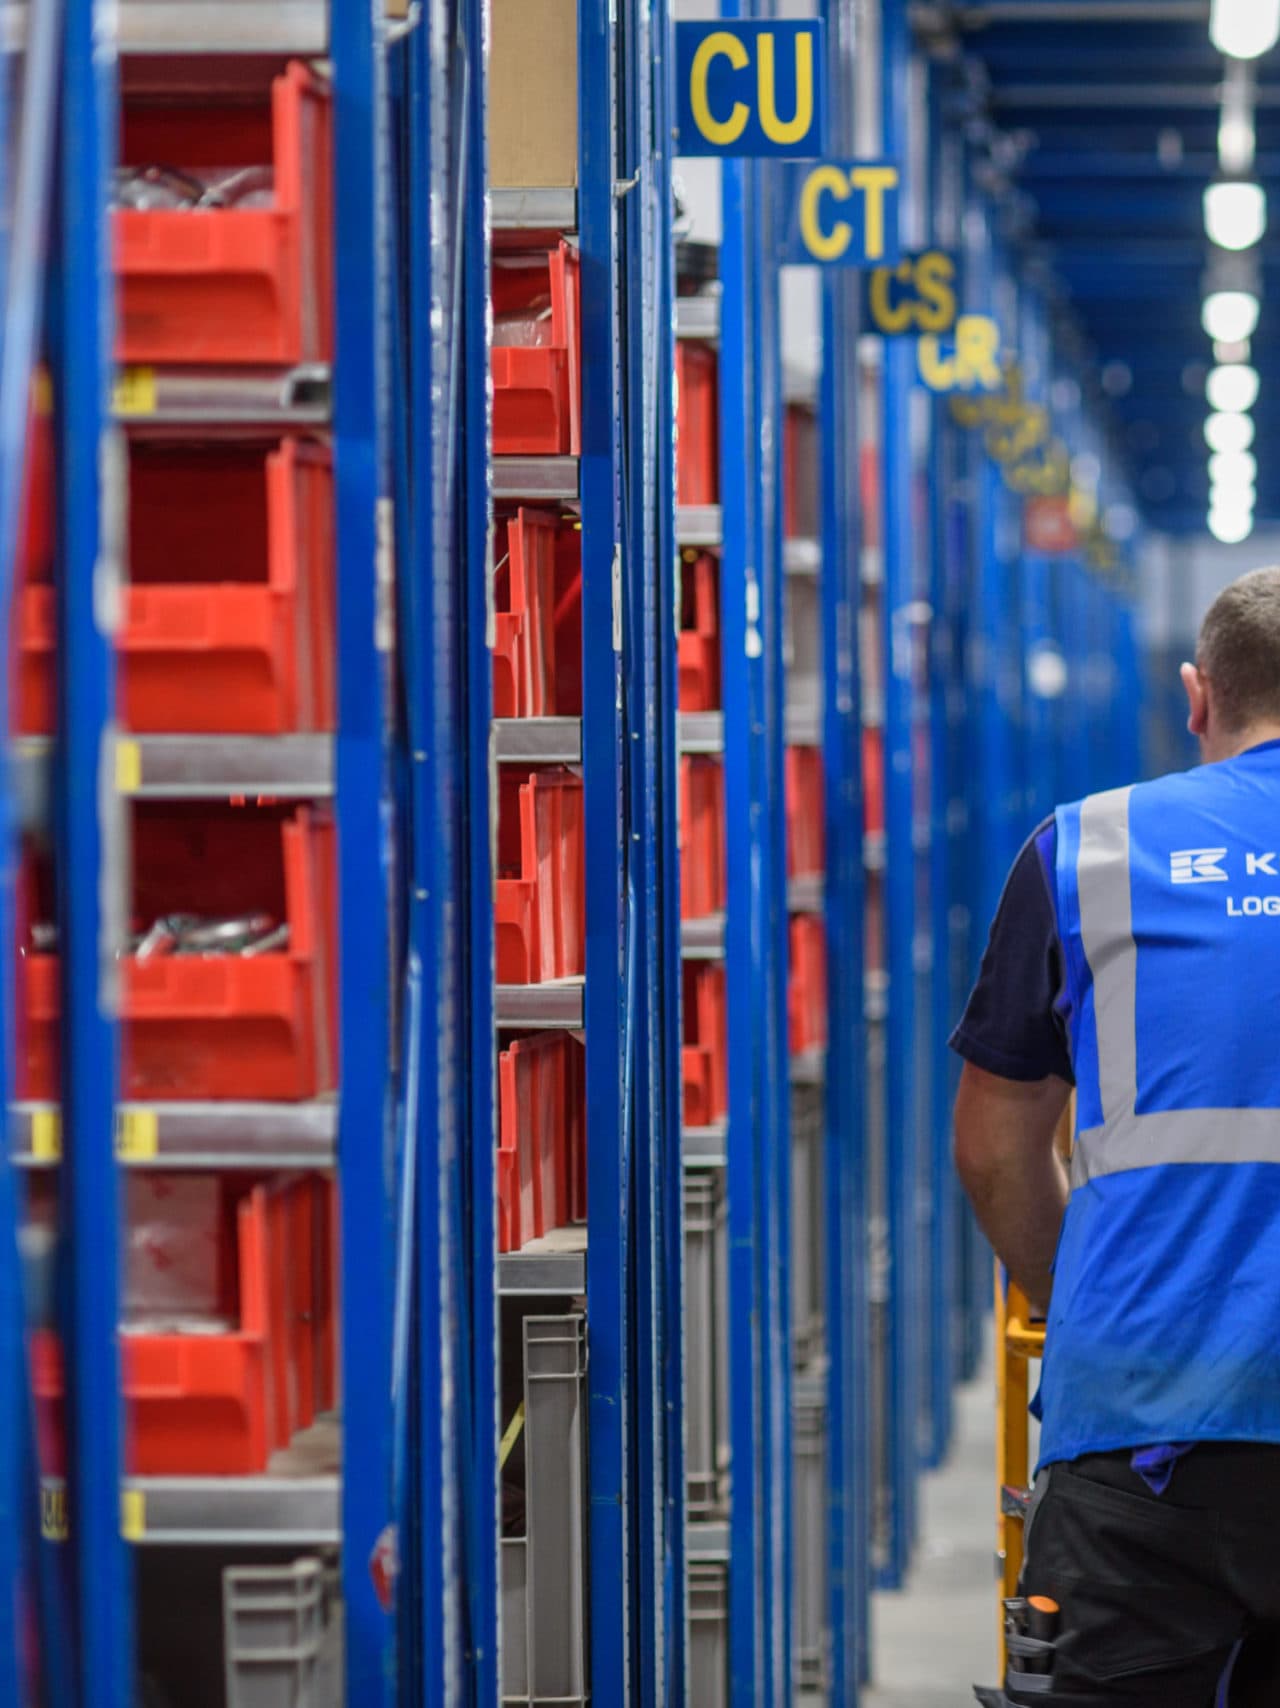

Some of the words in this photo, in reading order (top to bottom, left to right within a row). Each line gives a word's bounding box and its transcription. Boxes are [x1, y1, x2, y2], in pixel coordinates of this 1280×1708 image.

[690, 31, 813, 145] CU
[800, 165, 898, 260] CT
[869, 251, 956, 334] CS
